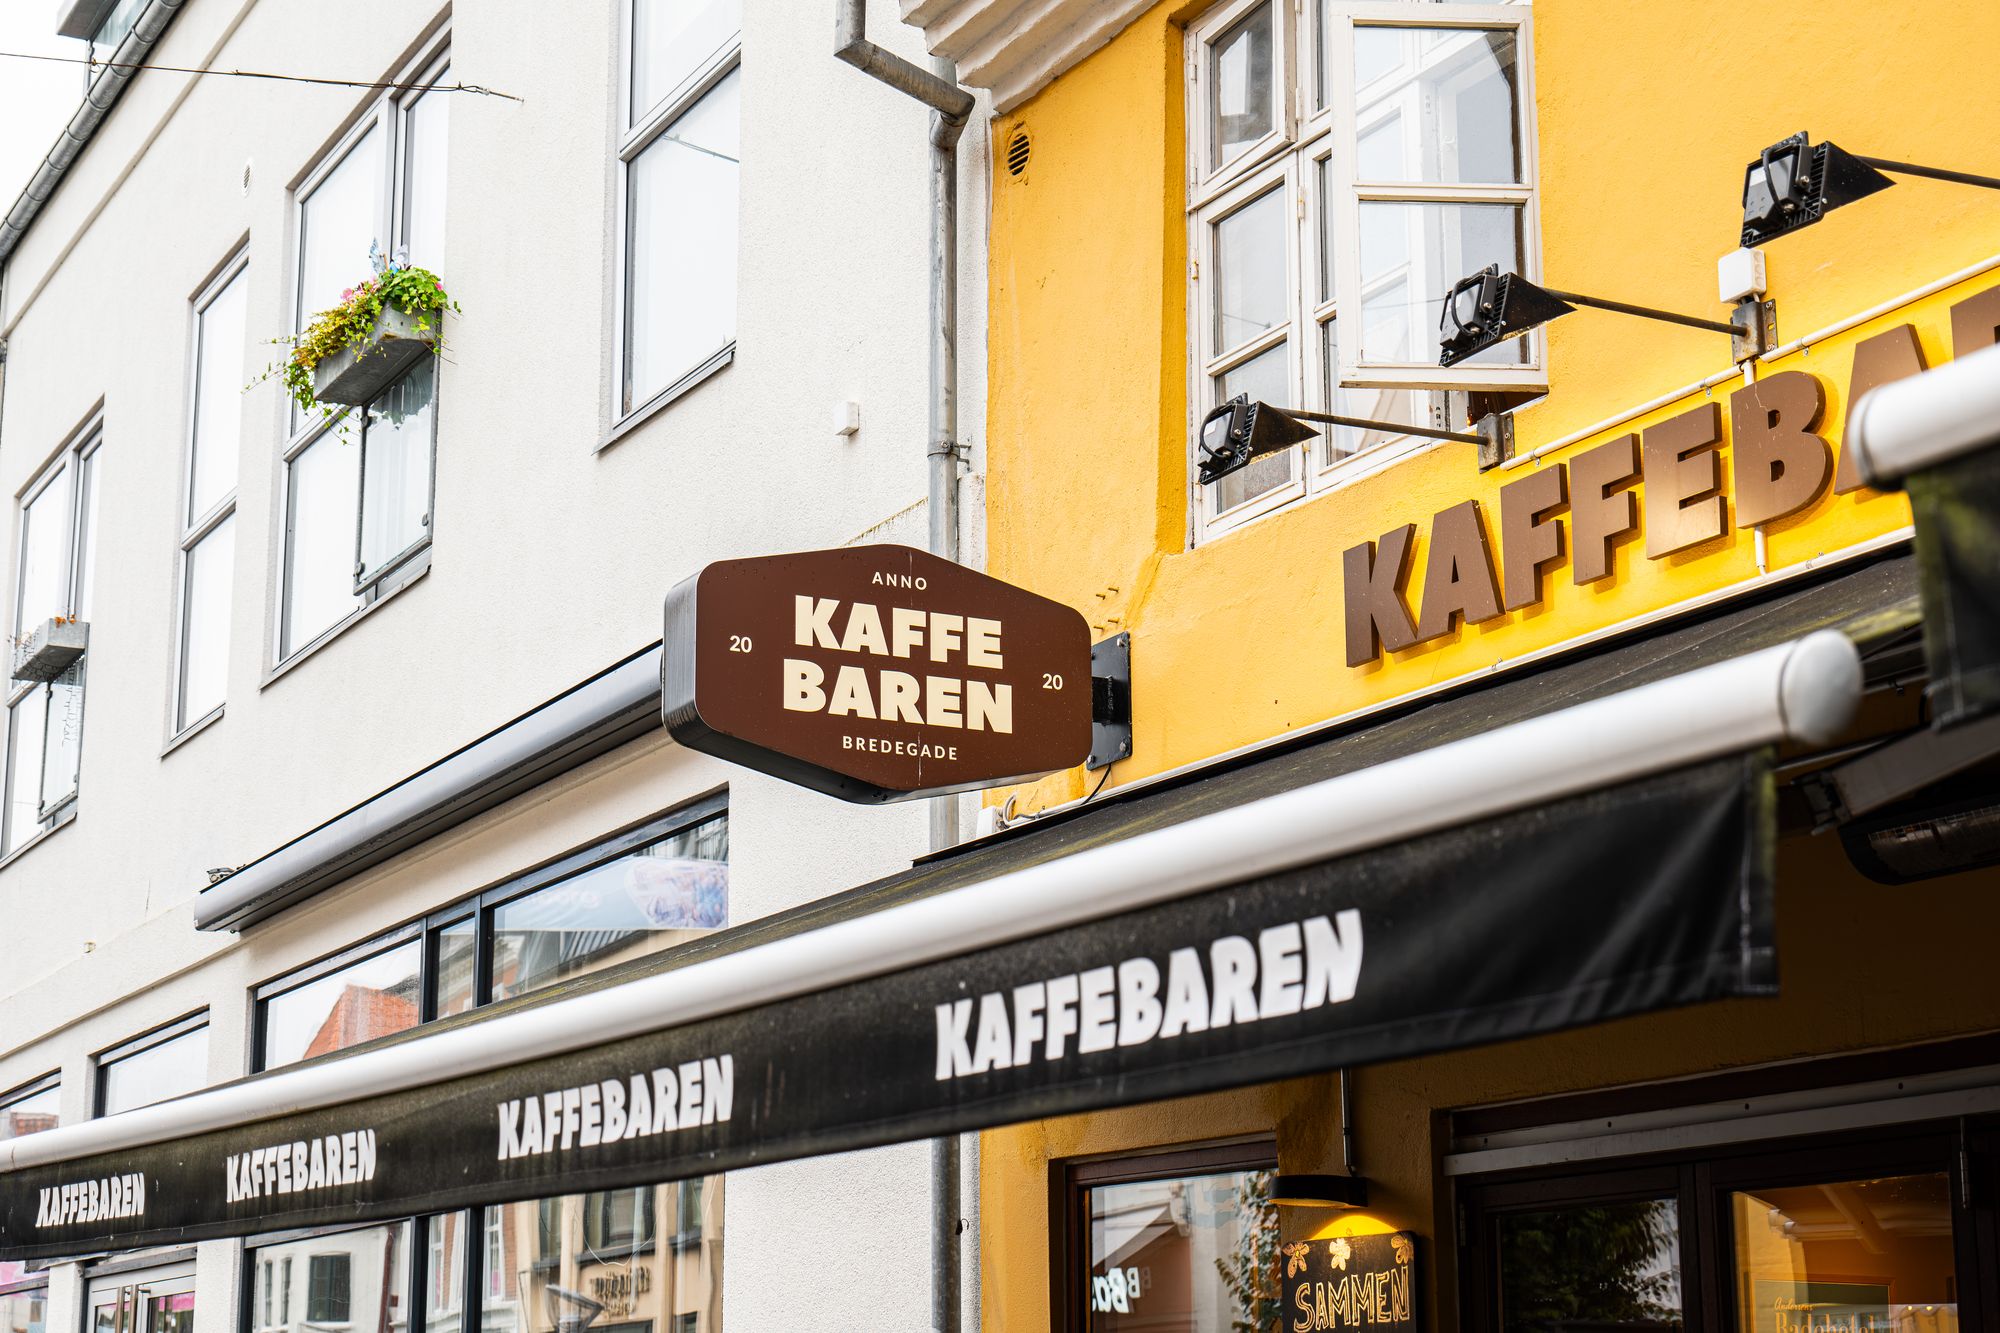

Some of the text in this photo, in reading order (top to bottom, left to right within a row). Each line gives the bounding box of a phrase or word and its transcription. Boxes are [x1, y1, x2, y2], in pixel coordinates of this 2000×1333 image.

[1343, 284, 2000, 668] KAFFEBA
[872, 571, 927, 590] ANNO
[729, 635, 752, 654] 20
[795, 594, 1003, 669] KAFFE
[783, 658, 1013, 734] BAREN
[1042, 673, 1063, 690] 20
[842, 735, 957, 760] BREDEGADE
[935, 908, 1364, 1081] KAFFEBAREN
[498, 1055, 735, 1160] KAFFEBAREN
[35, 1172, 145, 1228] KAFFEBAREN
[226, 1129, 376, 1203] KAFFEBAREN
[1293, 1265, 1410, 1333] SAMMEN
